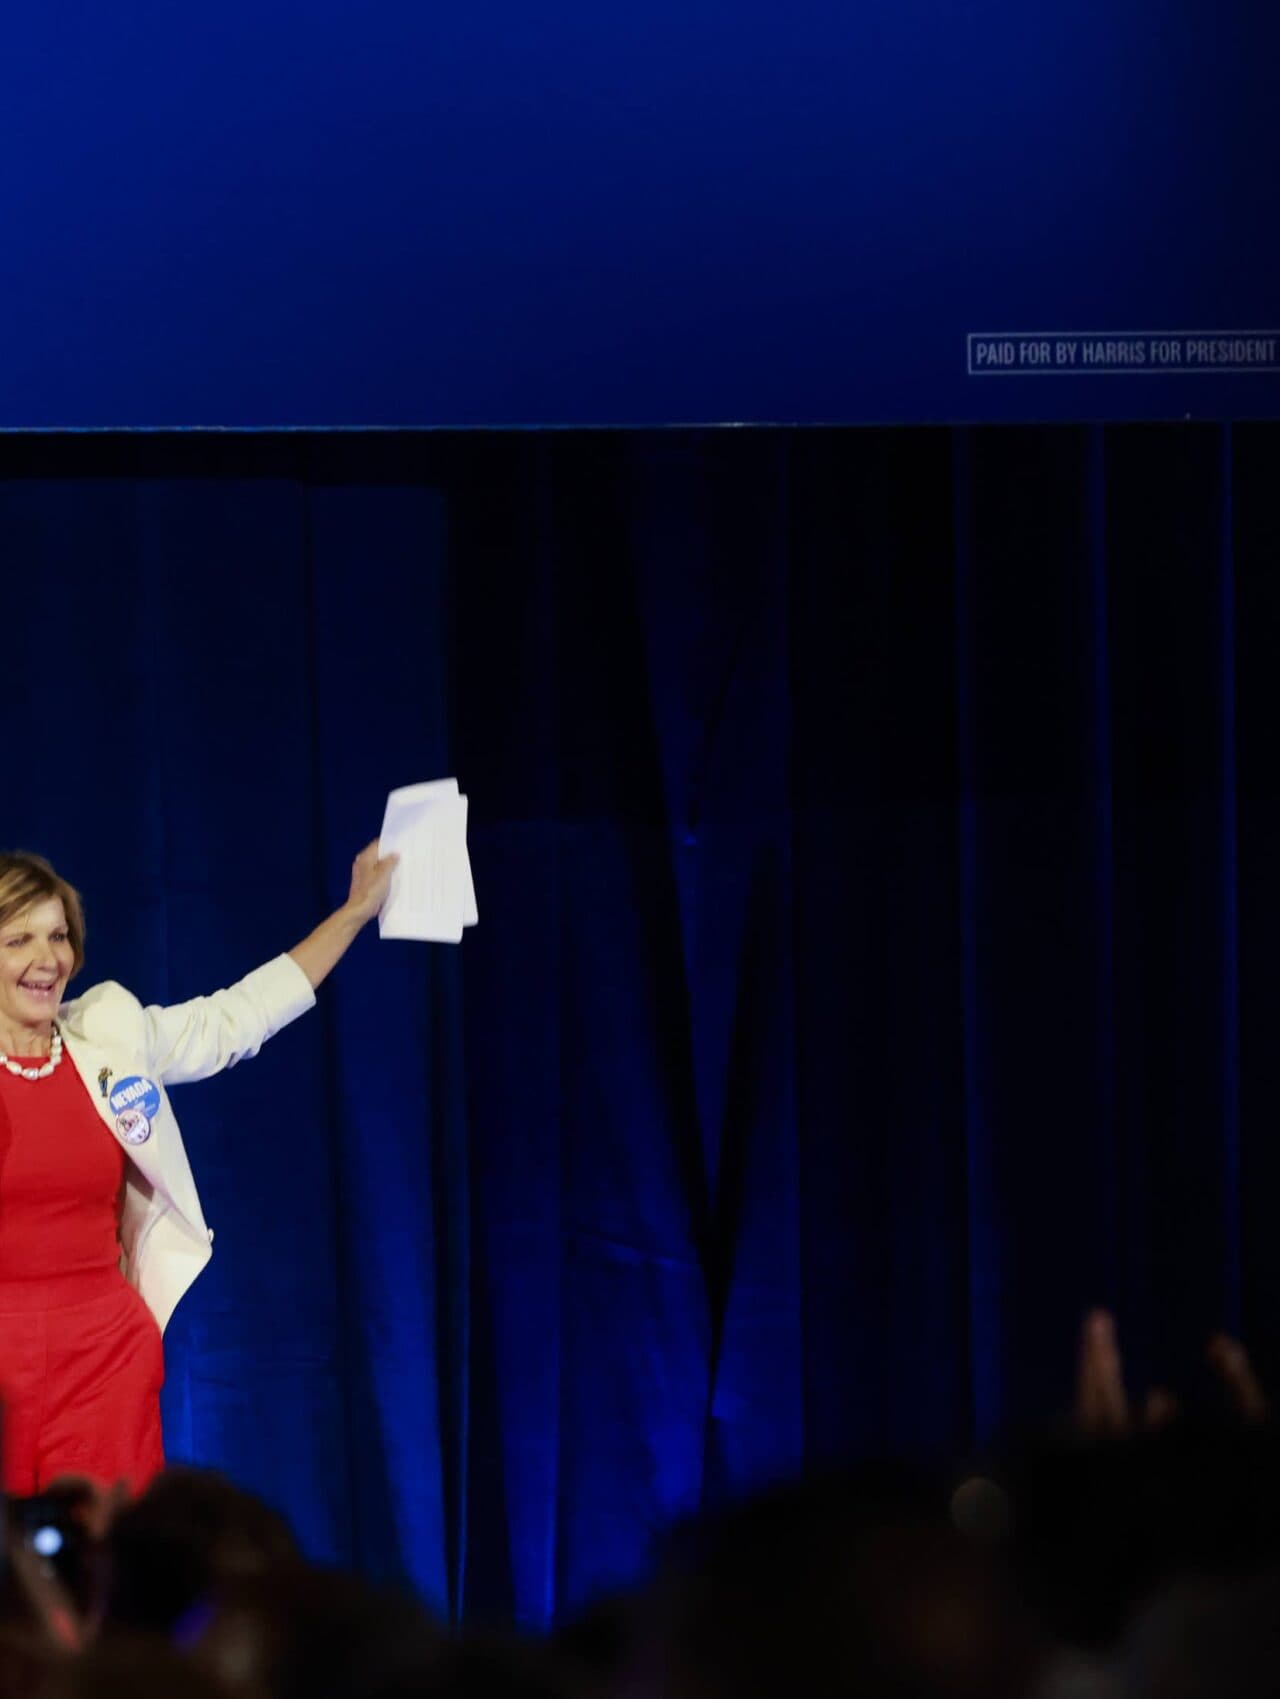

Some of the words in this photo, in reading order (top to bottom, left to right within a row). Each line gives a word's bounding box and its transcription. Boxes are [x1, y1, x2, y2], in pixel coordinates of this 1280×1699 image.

[976, 342, 1015, 365] PAID
[1019, 342, 1051, 365] FOR
[1055, 342, 1077, 364] BY
[1082, 341, 1146, 364] HARRIS
[1150, 340, 1181, 363] FOR
[1186, 339, 1276, 362] PRESIDENT
